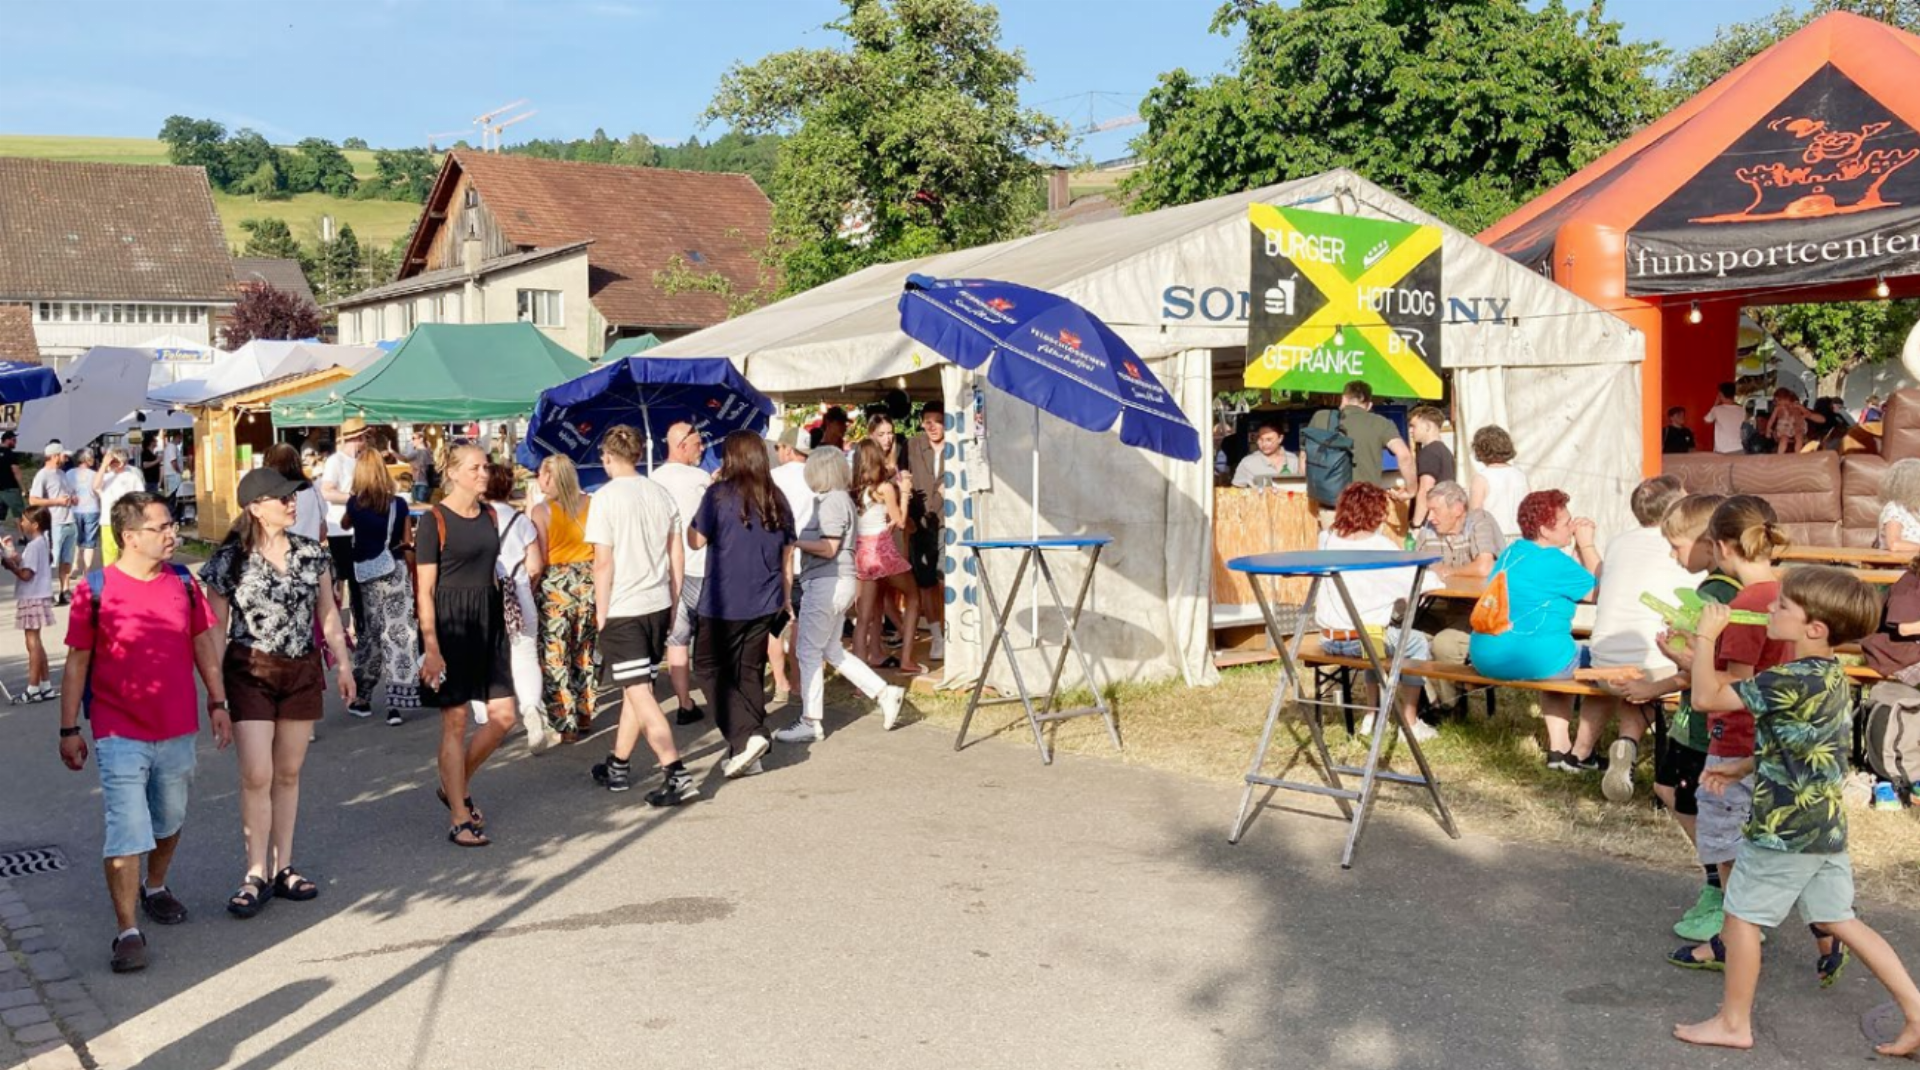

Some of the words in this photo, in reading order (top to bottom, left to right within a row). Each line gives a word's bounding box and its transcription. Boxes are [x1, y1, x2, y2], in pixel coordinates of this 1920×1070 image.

[1264, 227, 1346, 265] BURGER
[1636, 232, 1920, 278] funsportcenter
[1357, 285, 1395, 314] HOT
[1398, 288, 1436, 317] DOG
[1263, 343, 1365, 375] GETRÄNKE
